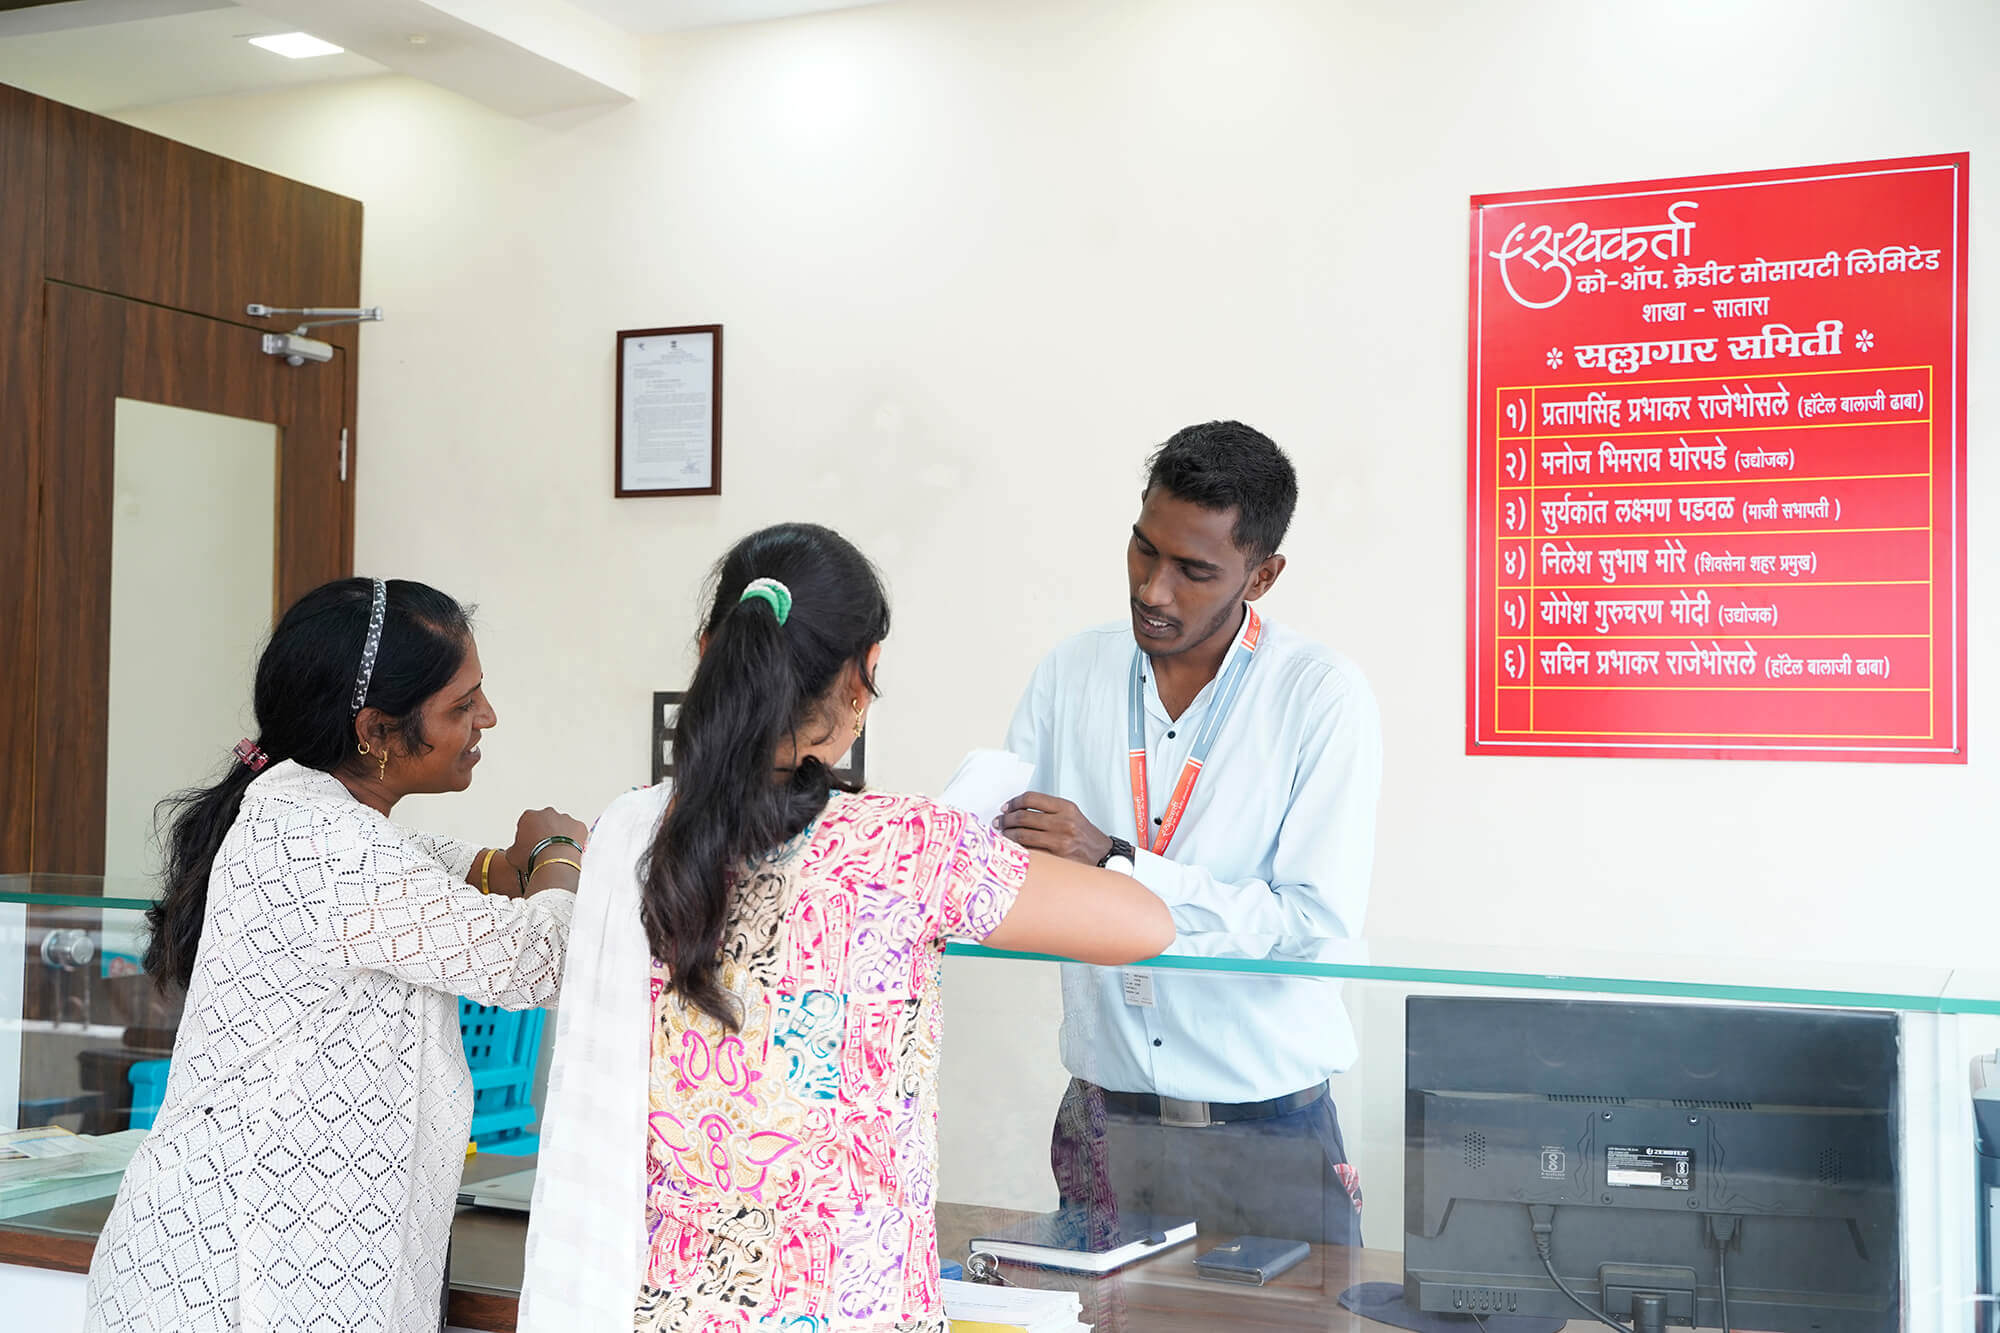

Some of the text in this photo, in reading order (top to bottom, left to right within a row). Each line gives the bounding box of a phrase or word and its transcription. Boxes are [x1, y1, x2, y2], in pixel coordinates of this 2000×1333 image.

[1672, 259, 1735, 288] क्रेडीट
[1739, 251, 1841, 283] सोसायटी
[1845, 246, 1941, 275] लिमिटेड
[1642, 303, 1686, 322] शाखा
[1712, 297, 1770, 318] सातारा
[1727, 320, 1843, 360] समिती
[1507, 382, 1923, 432] १) प्रतापसिंह प्रभाकर राजेभोसले (हॉटेल बालाजी ढाबा)
[1506, 436, 1794, 480] २) मनोज भिमराव घोरपडे (उद्योजक)
[1506, 497, 1526, 530] ३)
[1615, 499, 1672, 522] लक्ष्मण
[1678, 497, 1735, 521] पडवळ
[1743, 500, 1778, 523] (माजी
[1782, 496, 1830, 518] सभापती
[1505, 539, 1816, 583] ४) निलेश सुभाष मोरे (शिवसेना शहर प्रमुख)
[1504, 590, 1777, 633] ५) योगेश गुरुचरण मोदी (उद्योजक)
[1504, 640, 1889, 678] ६) सचिन प्रभाकर राजेभोसले (हॉटेल बालाजी ढाबा)
